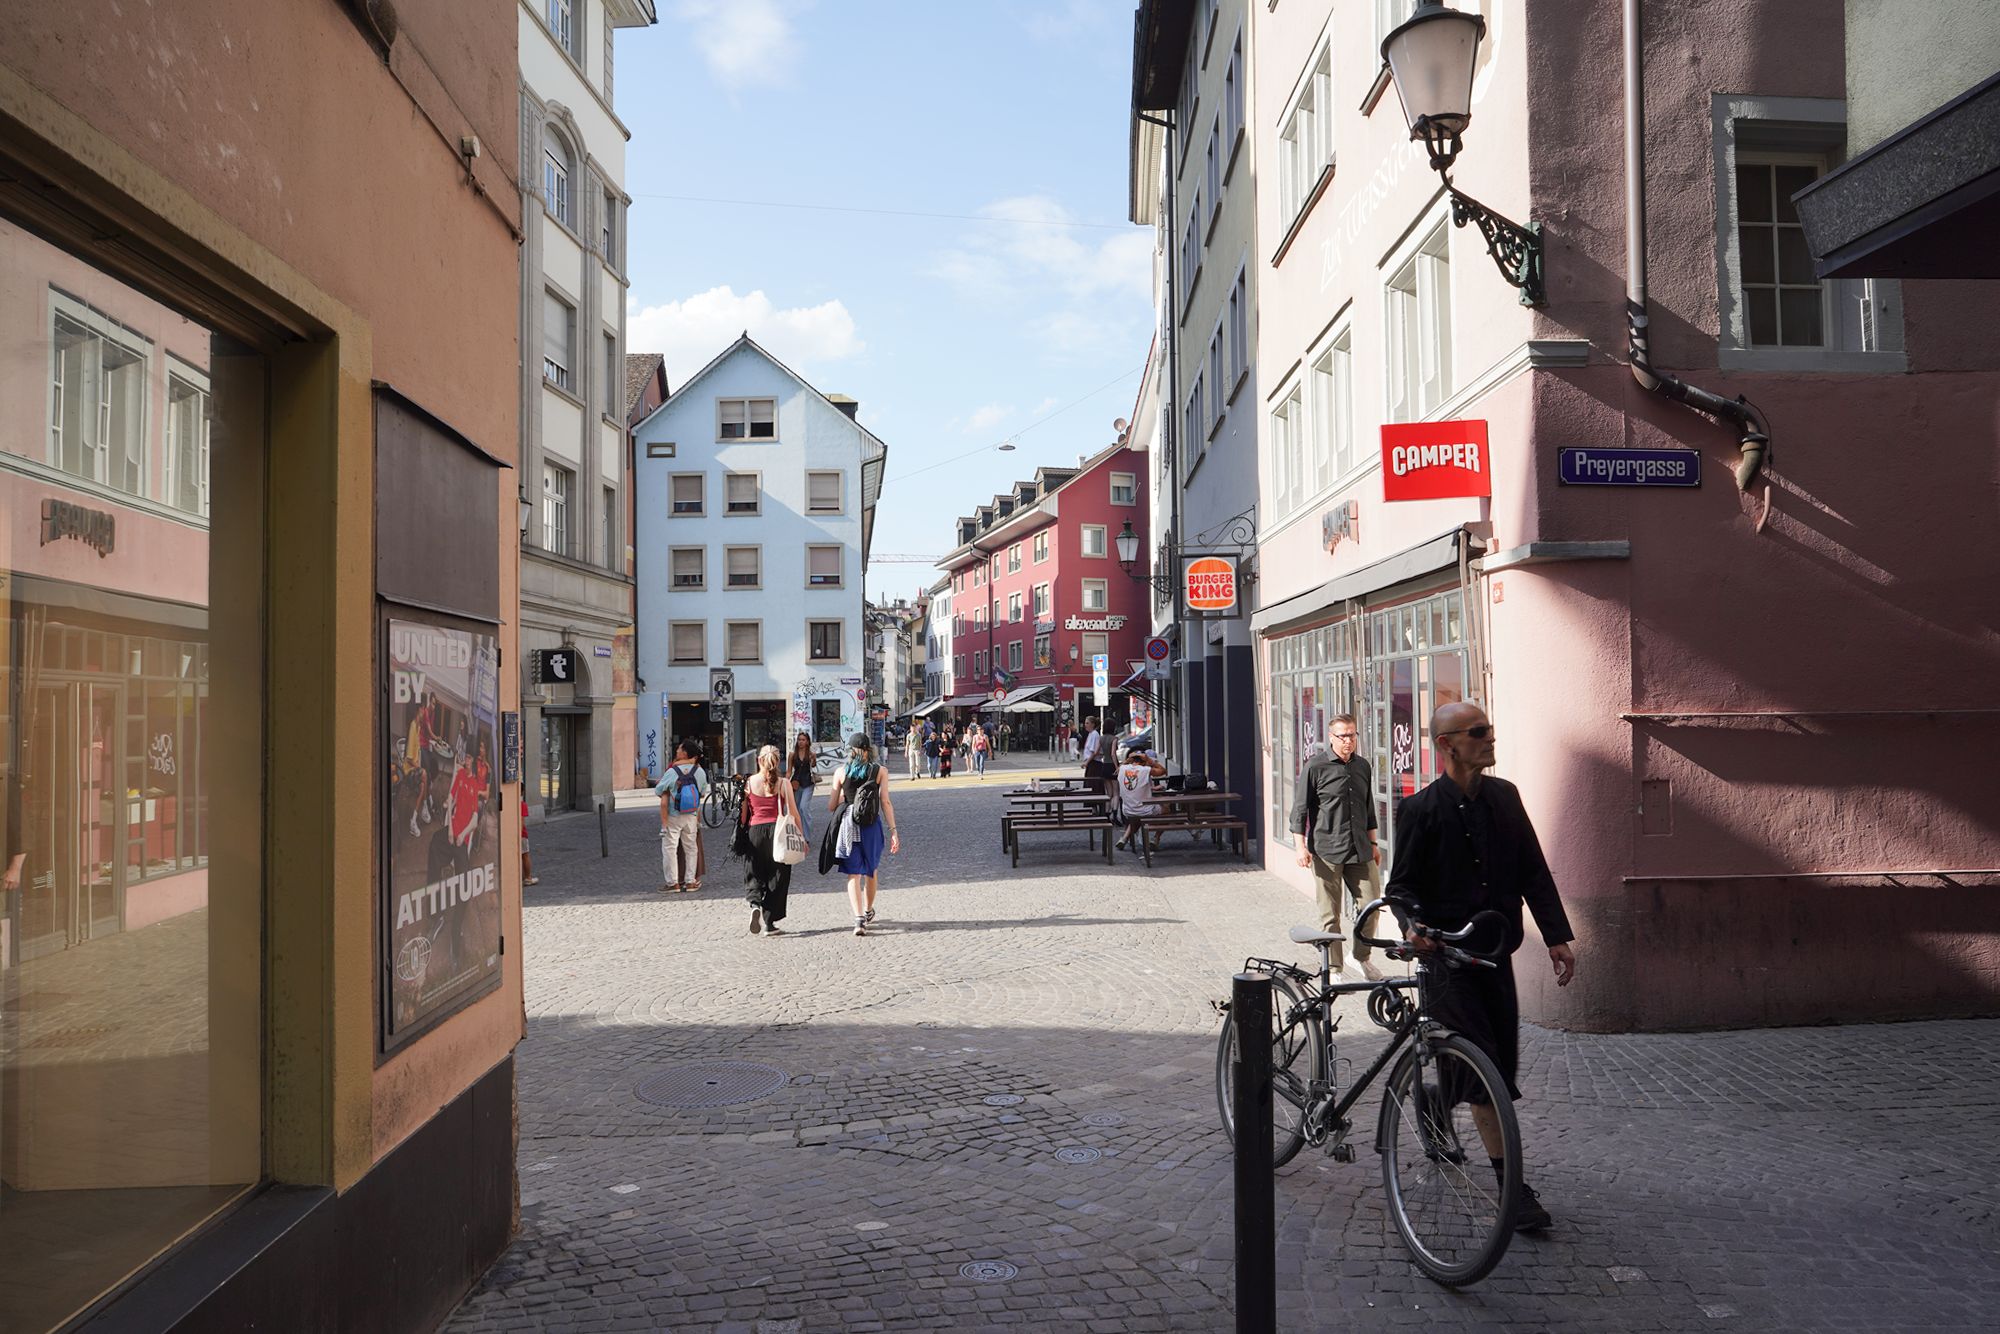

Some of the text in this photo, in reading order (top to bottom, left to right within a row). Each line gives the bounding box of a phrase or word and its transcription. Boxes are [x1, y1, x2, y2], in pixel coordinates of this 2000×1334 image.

[1392, 443, 1480, 476] CAMPER
[1575, 451, 1686, 482] Preyergasse
[1188, 573, 1233, 585] BURGER
[1189, 584, 1234, 599] KING
[1064, 614, 1124, 631] alexander
[394, 631, 471, 669] UNITED
[394, 671, 426, 704] BY
[396, 862, 495, 930] ATTITUDE
